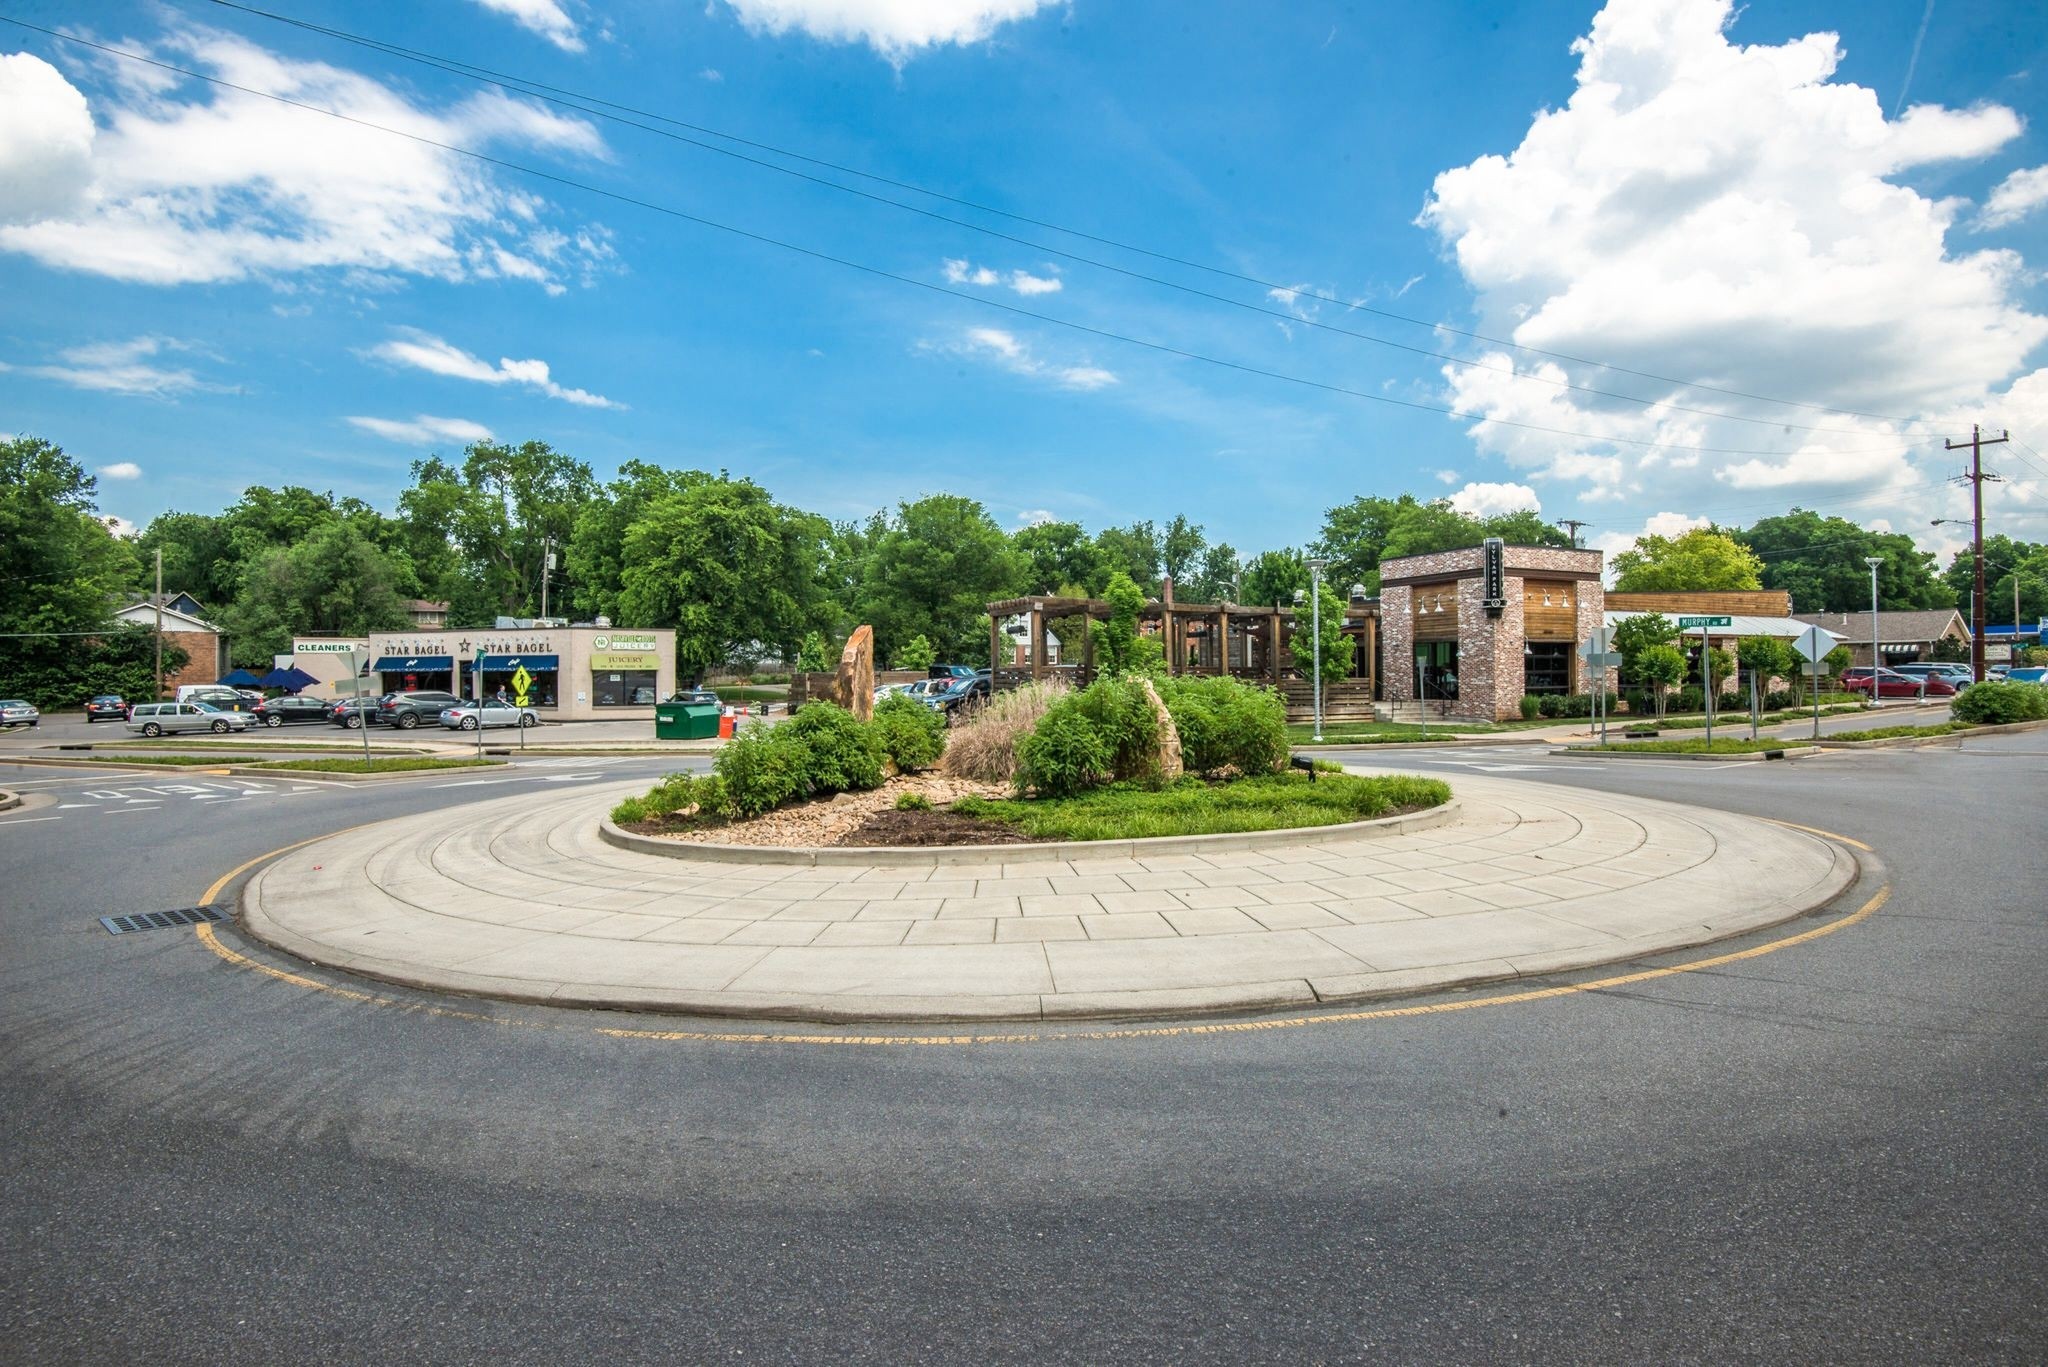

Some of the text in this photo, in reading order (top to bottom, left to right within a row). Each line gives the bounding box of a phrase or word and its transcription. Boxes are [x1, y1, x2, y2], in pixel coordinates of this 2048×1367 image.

[1682, 618, 1711, 626] MURPHY
[297, 644, 352, 652] CLEANERS
[384, 645, 447, 655] STAR BAGEL
[483, 643, 553, 653] STAR BAGEL
